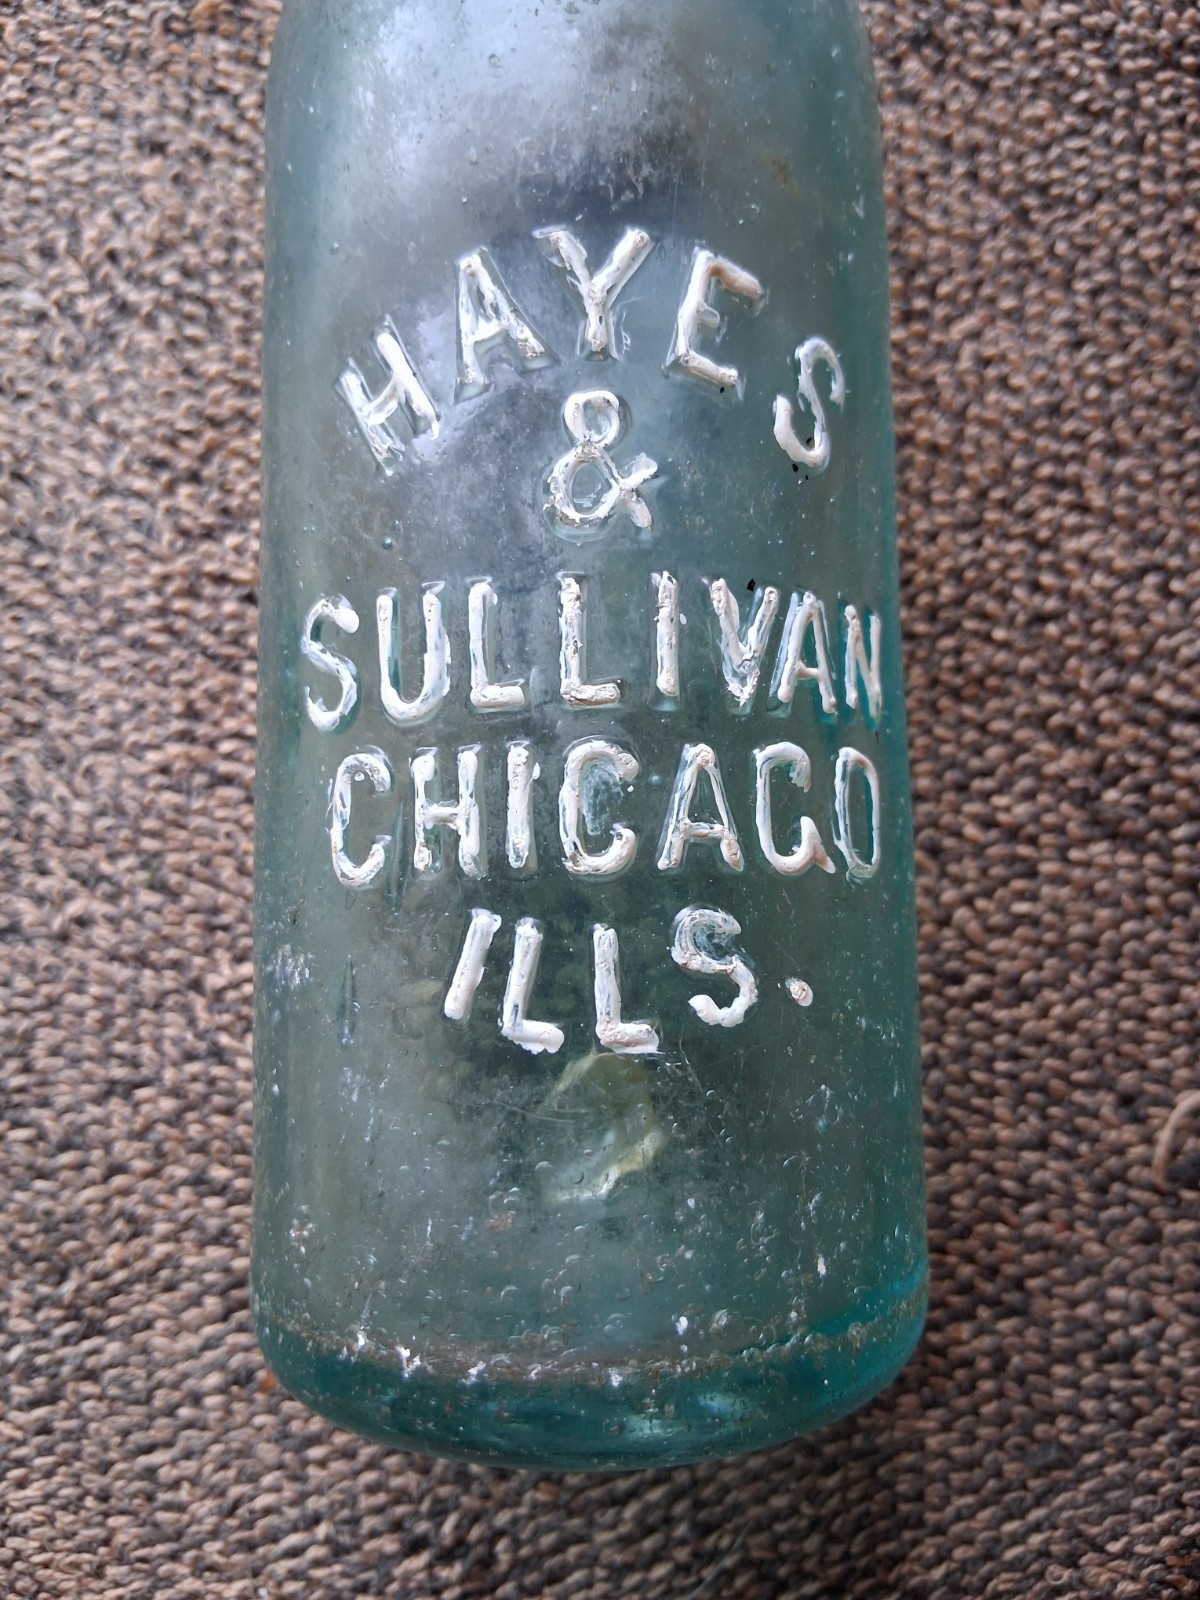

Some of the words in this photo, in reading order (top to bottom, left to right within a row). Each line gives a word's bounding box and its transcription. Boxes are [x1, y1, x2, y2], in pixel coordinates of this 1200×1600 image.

[339, 225, 846, 475] HAYES
[546, 389, 659, 531] &
[301, 570, 883, 731] SULLIVAN
[330, 739, 882, 887] CHICAGO
[443, 907, 813, 1054] ILLS.
